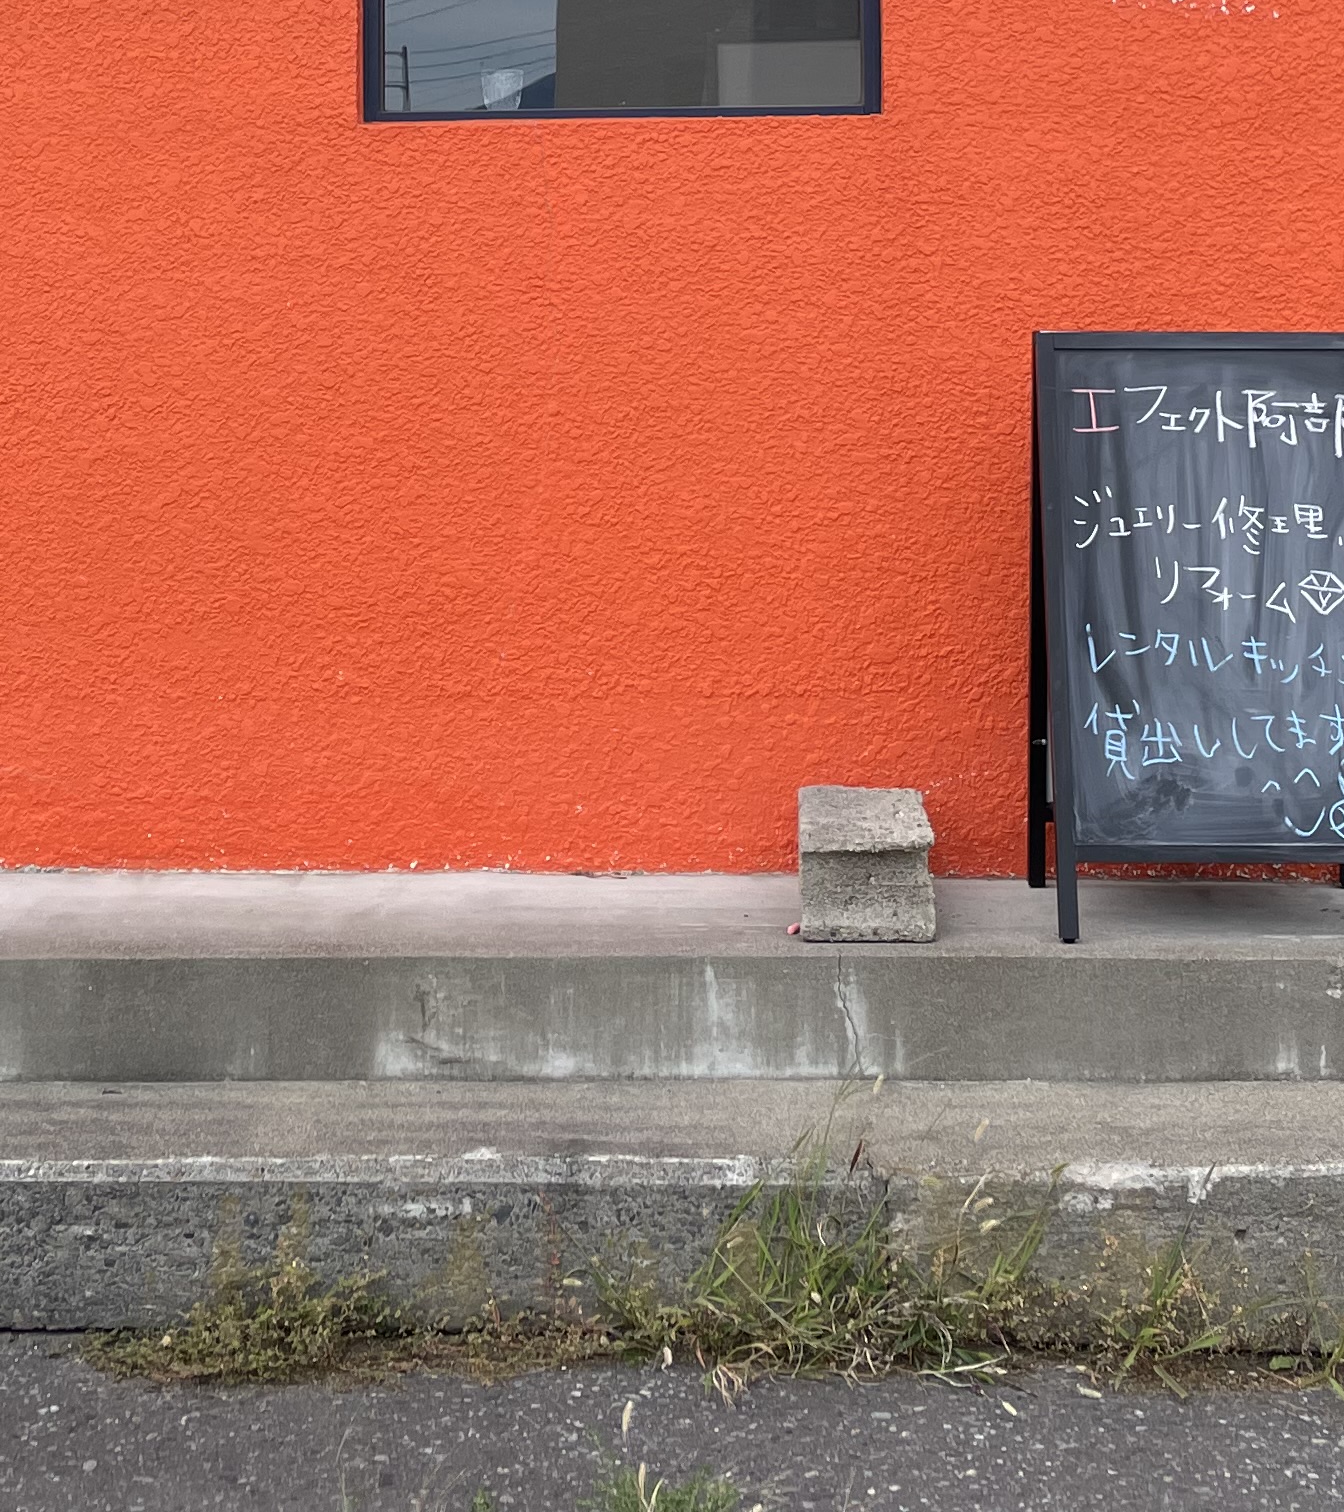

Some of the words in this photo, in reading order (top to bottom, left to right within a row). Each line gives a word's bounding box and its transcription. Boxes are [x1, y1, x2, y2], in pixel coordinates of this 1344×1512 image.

[1155, 555, 1296, 624] リフォーム
